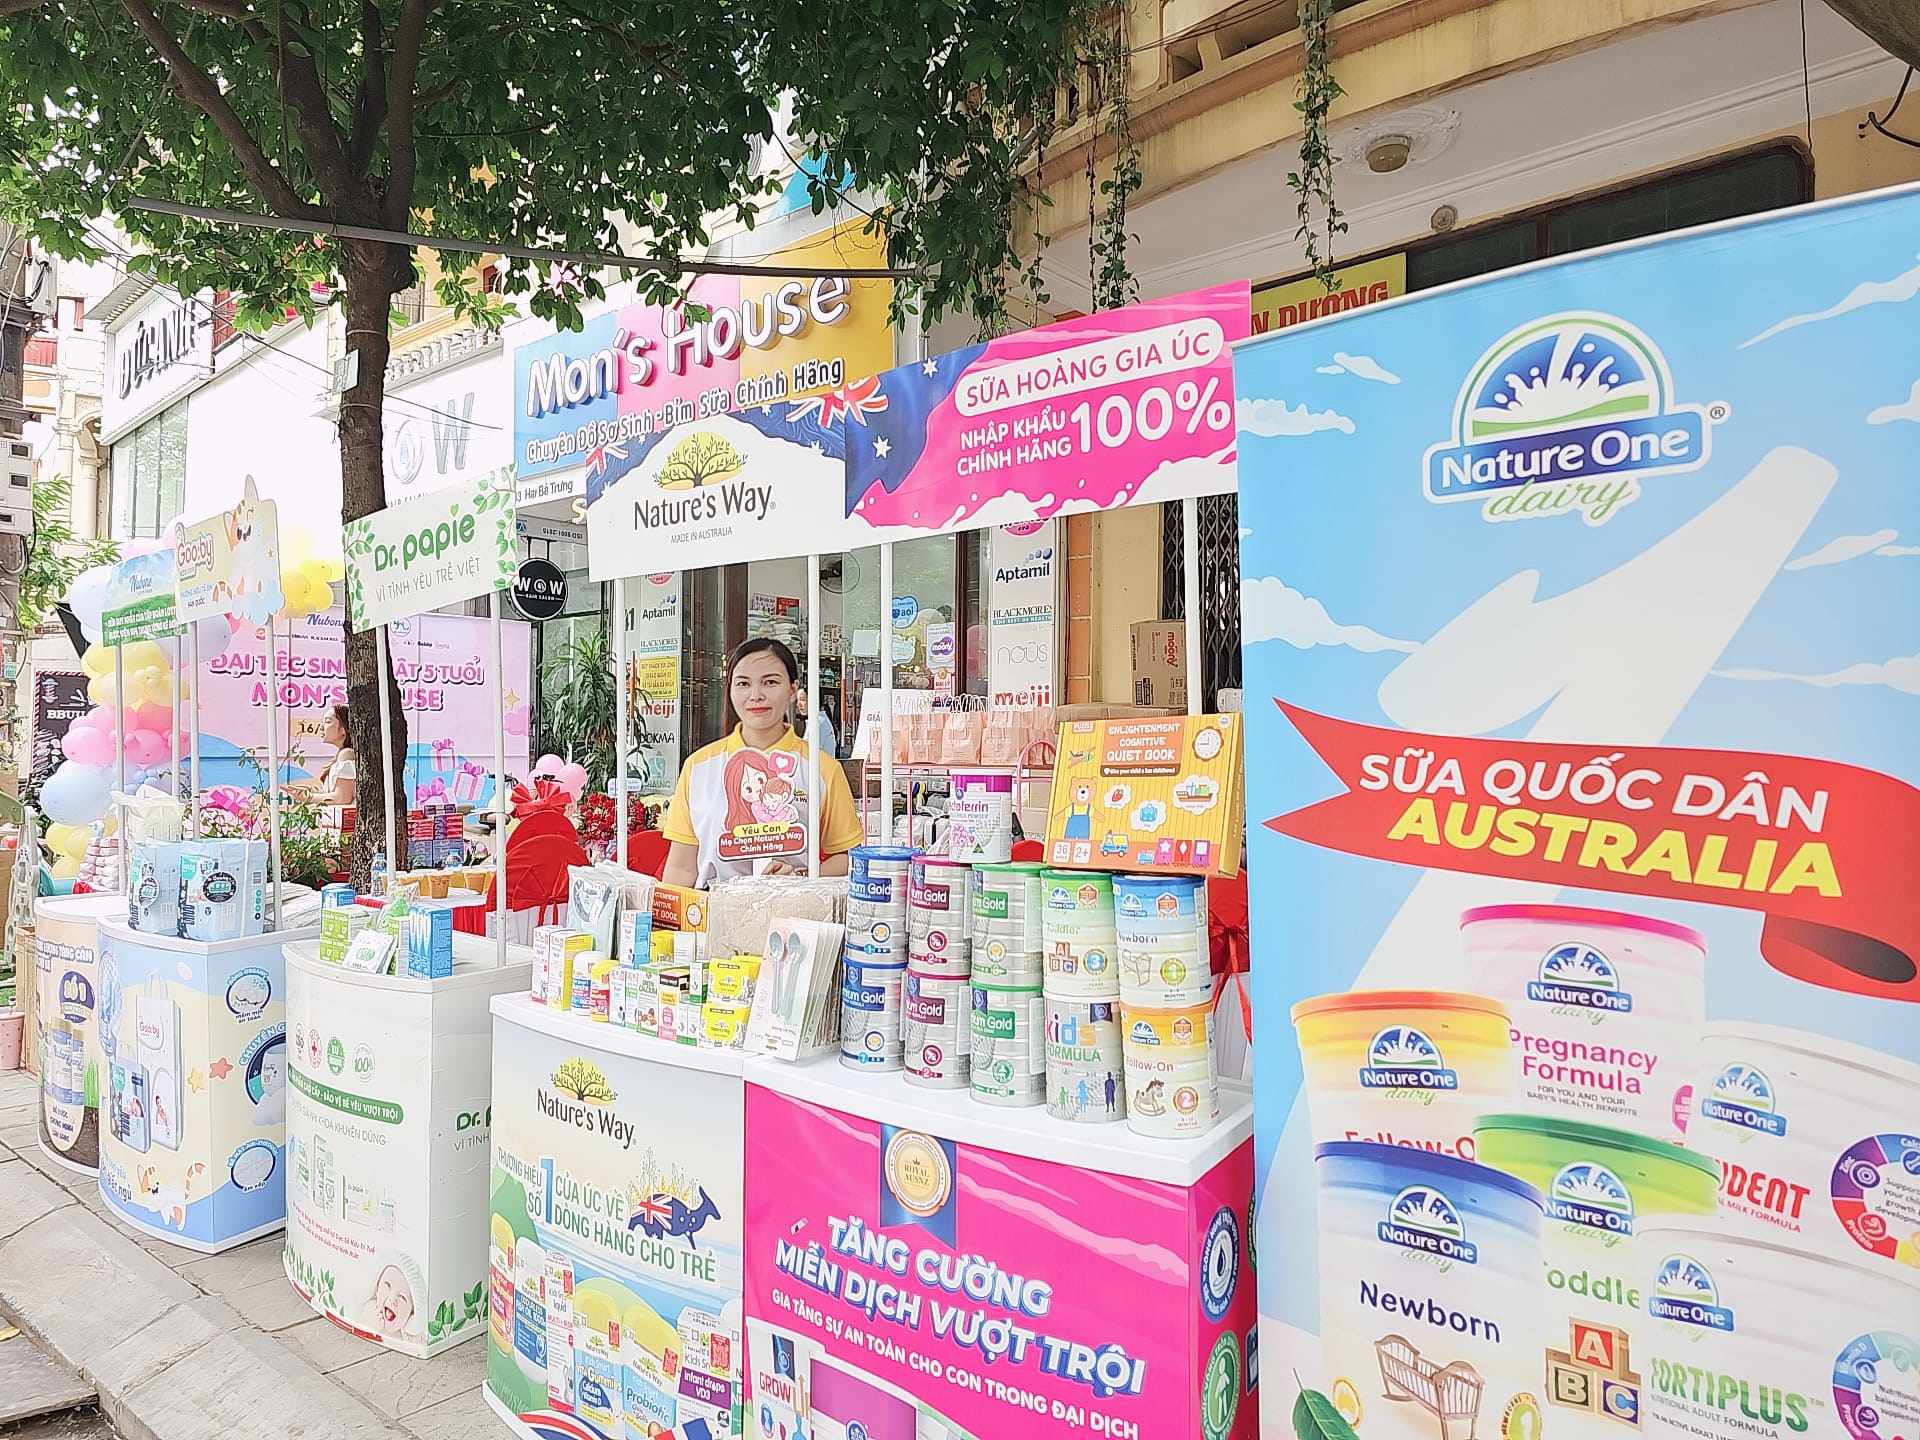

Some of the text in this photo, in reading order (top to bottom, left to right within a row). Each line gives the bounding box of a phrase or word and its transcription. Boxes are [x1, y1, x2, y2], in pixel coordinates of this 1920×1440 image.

[527, 276, 851, 419] Mon's House
[966, 328, 1212, 409] SỮA HOÀNG GIA ÚC
[620, 410, 654, 440] Sinh
[698, 386, 732, 418] Sữa
[735, 373, 787, 407] Chính
[794, 356, 844, 390] Hãng
[960, 404, 1067, 451] NHẬP KHẨU
[1070, 376, 1232, 454] 100%
[957, 432, 1073, 477] CHÍNH HÃNG
[1440, 425, 1692, 490] Nature One
[633, 491, 718, 533] Nature's
[720, 481, 772, 523] Way
[1488, 478, 1634, 521] dairy
[374, 508, 476, 573] Dr. papie
[670, 533, 691, 545] MADE
[387, 579, 411, 598] TÌNH
[413, 570, 433, 592] YÊU
[436, 560, 455, 582] TRẺ
[457, 556, 481, 579] VIỆT
[995, 562, 1050, 584] Aptamil
[641, 605, 676, 621] Aptamil
[423, 664, 438, 684] 5
[440, 655, 485, 685] TUỔI
[640, 699, 675, 719] meiji
[994, 684, 1050, 707] meiji
[1107, 749, 1176, 762] QUIET BOOK
[1119, 736, 1167, 748] COGNITIVE
[1358, 745, 1832, 834] SỮA QUỐC DÂN
[762, 824, 781, 834] Con
[786, 831, 802, 841] Way
[1075, 846, 1089, 858] 2+
[1387, 797, 1846, 899] AUSTRALIA
[867, 882, 892, 895] Gold
[923, 890, 947, 903] Gold
[982, 896, 1006, 911] Gold
[860, 991, 885, 1004] Gold
[918, 1002, 943, 1017] Gold
[1529, 980, 1630, 1013] Nature One
[986, 1015, 1013, 1031] Gold
[1508, 1028, 1658, 1076] Pregnancy
[1361, 1069, 1454, 1088] Nature One
[1521, 1055, 1643, 1096] Formula
[1537, 1085, 1626, 1107] FOR YOU AND YOUR
[1557, 1096, 1595, 1110] HEALTH
[1596, 1103, 1638, 1117] BENEFITS
[456, 1110, 481, 1132] Dr.
[536, 1088, 637, 1150] Nature's Way
[1702, 1103, 1745, 1126] Nature
[1744, 1111, 1779, 1132] One
[540, 1157, 555, 1224] 1
[554, 1170, 580, 1202] CỦA
[583, 1183, 602, 1211] ÚC
[604, 1188, 625, 1223] VỀ
[1544, 1203, 1603, 1230] Nature
[1750, 1208, 1802, 1234] FORMULA
[554, 1202, 717, 1283] DÒNG HÀNG CHO TRẺ
[1382, 1224, 1474, 1261] Nature One
[827, 1215, 1053, 1319] TĂNG CƯỜNG
[775, 1233, 842, 1298] MIỄN
[844, 1270, 922, 1329] DỊCH
[930, 1299, 1036, 1363] VƯỢT
[1044, 1334, 1146, 1396] TRỘI
[1359, 1279, 1501, 1344] Newborn
[1650, 1301, 1726, 1327] Nature One
[1578, 1326, 1610, 1369] A
[771, 1288, 1140, 1440] GIA TĂNG SỰ AN TOÀN CHO CON TRONG ĐẠI DỊCH
[684, 1369, 726, 1394] Infant drops
[695, 1386, 712, 1401] VD3
[760, 1371, 791, 1404] GROW
[1557, 1370, 1637, 1423] B C
[626, 1387, 671, 1425] Probiotic
[1723, 1416, 1779, 1439] FORMULA
